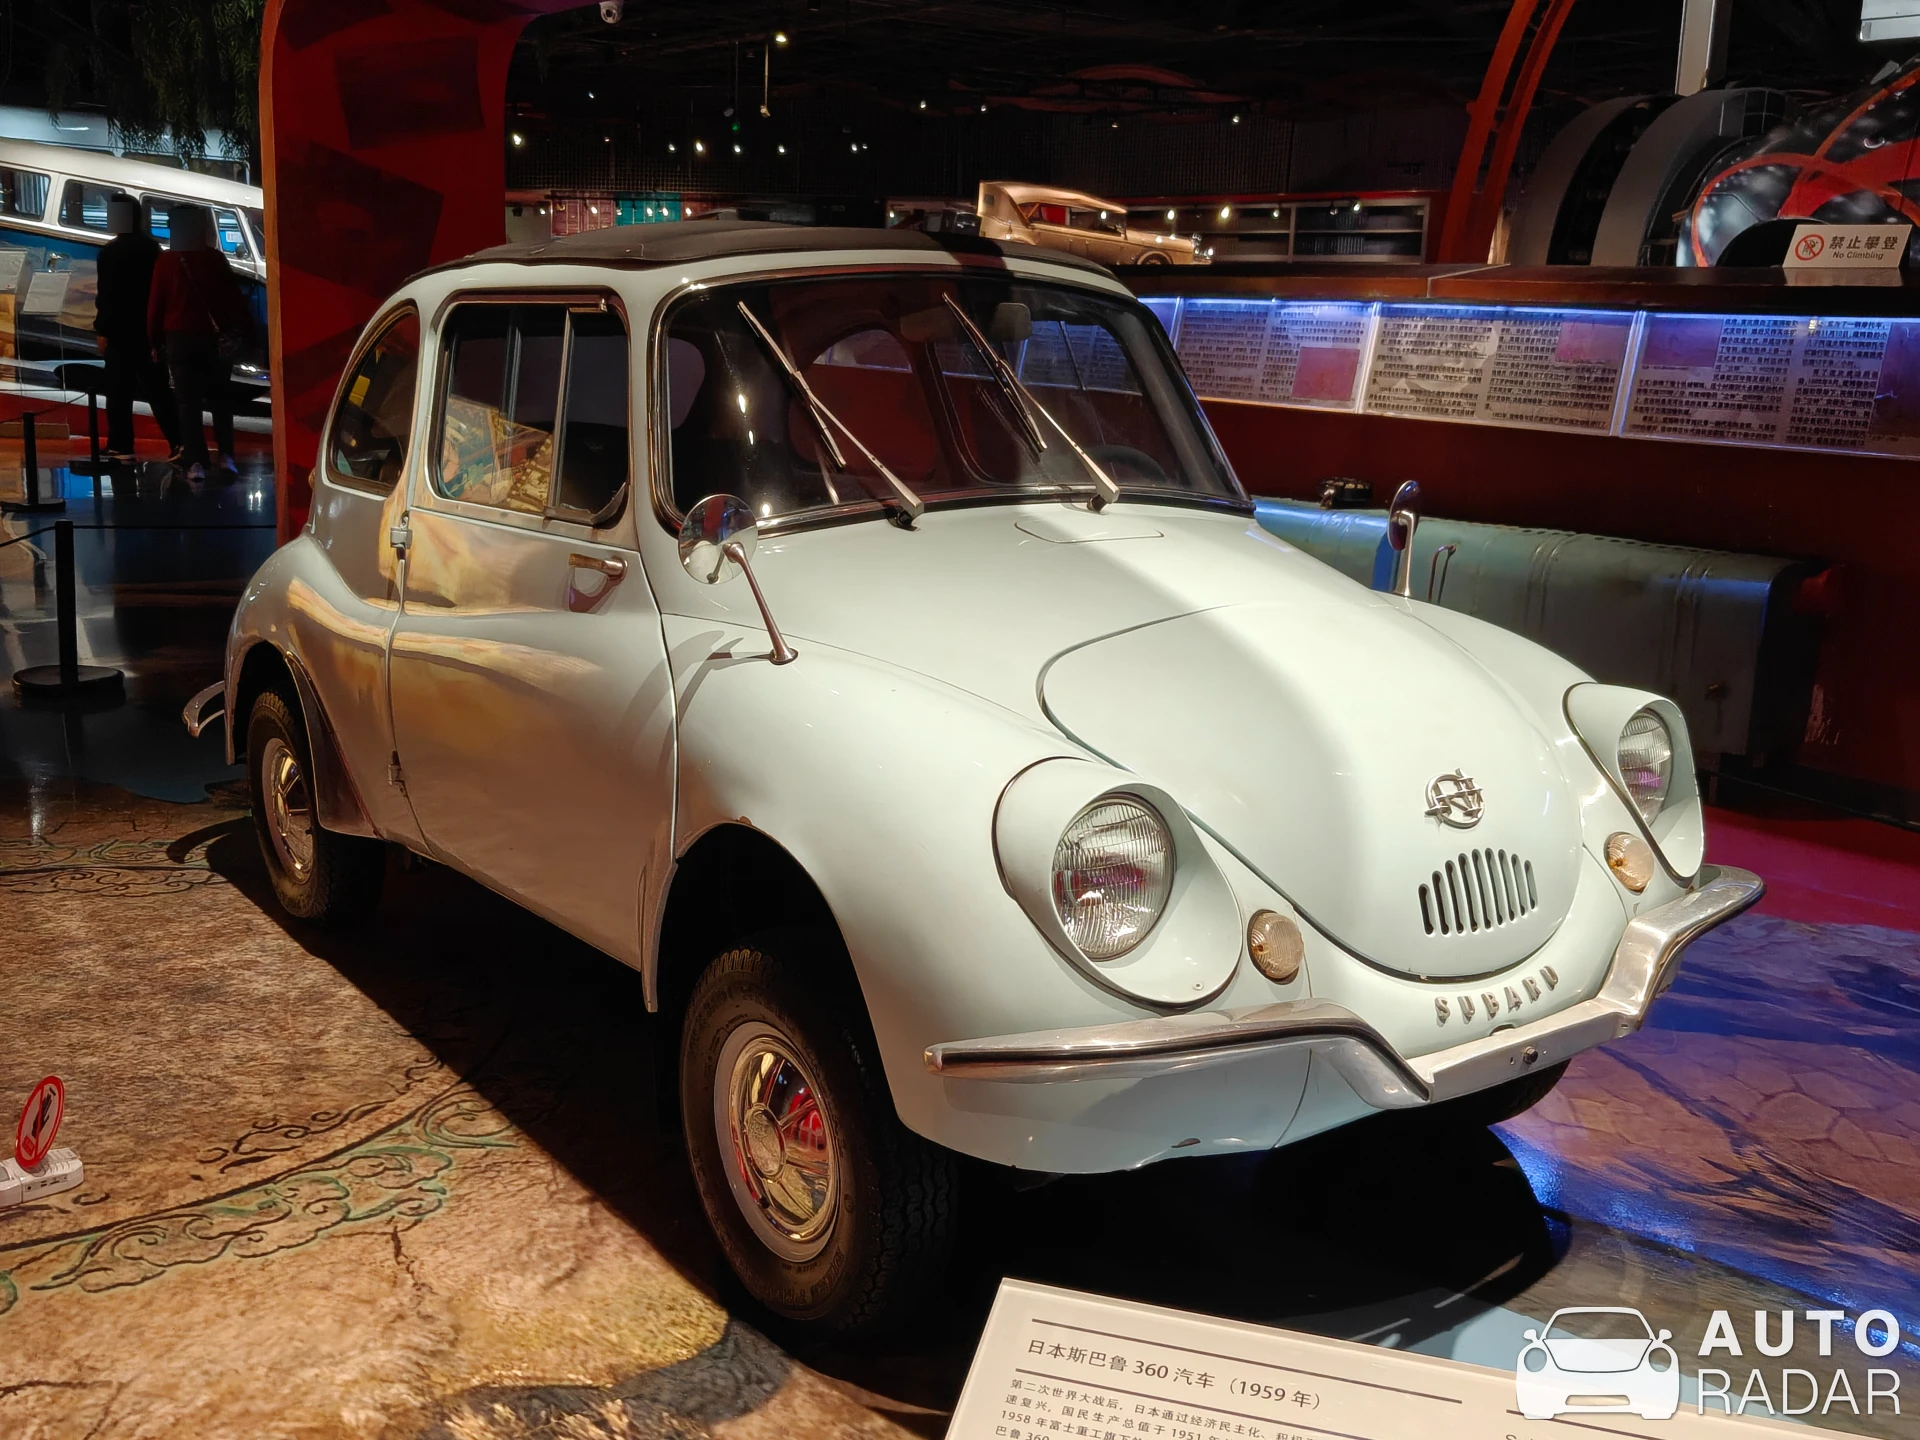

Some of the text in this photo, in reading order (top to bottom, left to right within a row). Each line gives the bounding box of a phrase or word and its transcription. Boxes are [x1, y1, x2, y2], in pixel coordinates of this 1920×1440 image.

[1832, 251, 1884, 261] No Climbing
[1027, 1338, 1129, 1372] 日本斯巴鲁
[1132, 1360, 1169, 1380] 360
[1001, 1410, 1031, 1424] 1958
[995, 1425, 1021, 1440] 巴鲁
